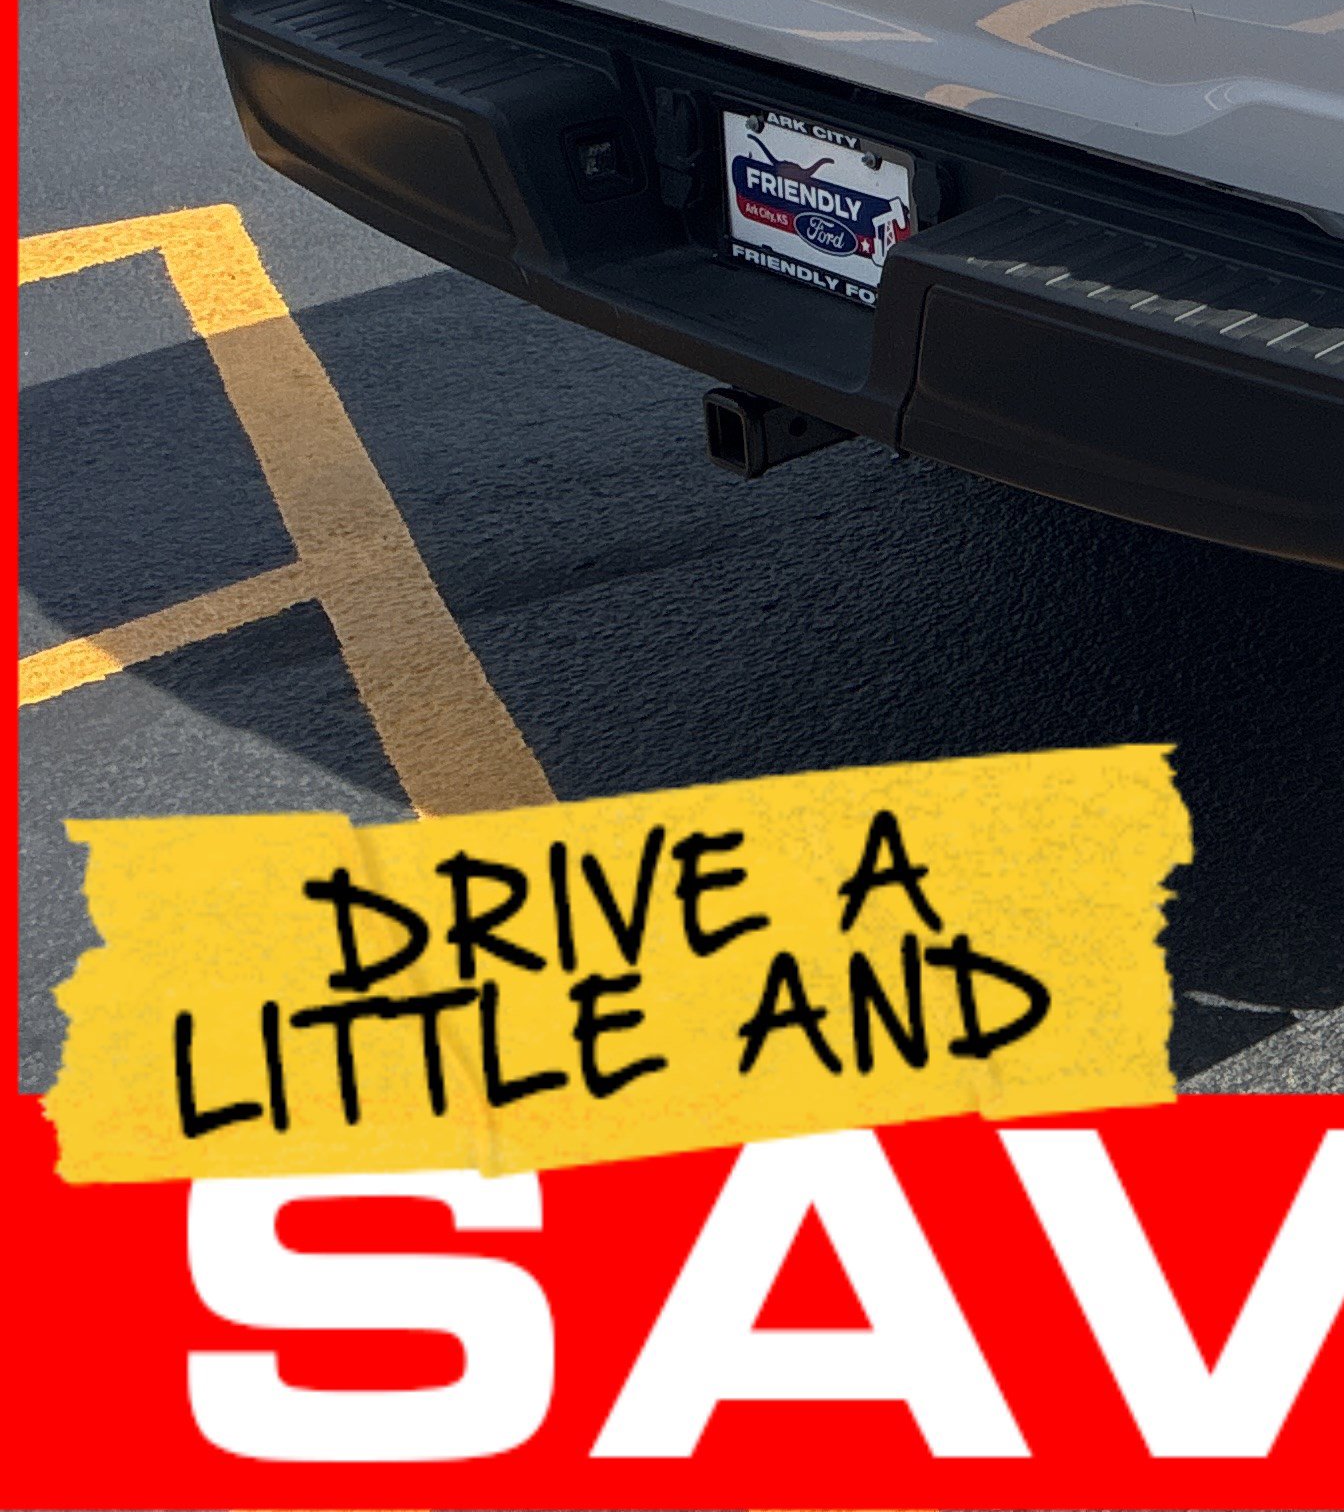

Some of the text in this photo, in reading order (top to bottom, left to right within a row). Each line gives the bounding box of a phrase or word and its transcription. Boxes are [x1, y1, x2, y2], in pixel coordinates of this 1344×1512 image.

[766, 111, 859, 150] ARK CITY
[745, 165, 863, 222] FRIENDLY
[745, 202, 759, 216] Ark
[776, 213, 789, 227] KS
[805, 216, 846, 250] Ford
[731, 244, 878, 306] FRIENDLY FO
